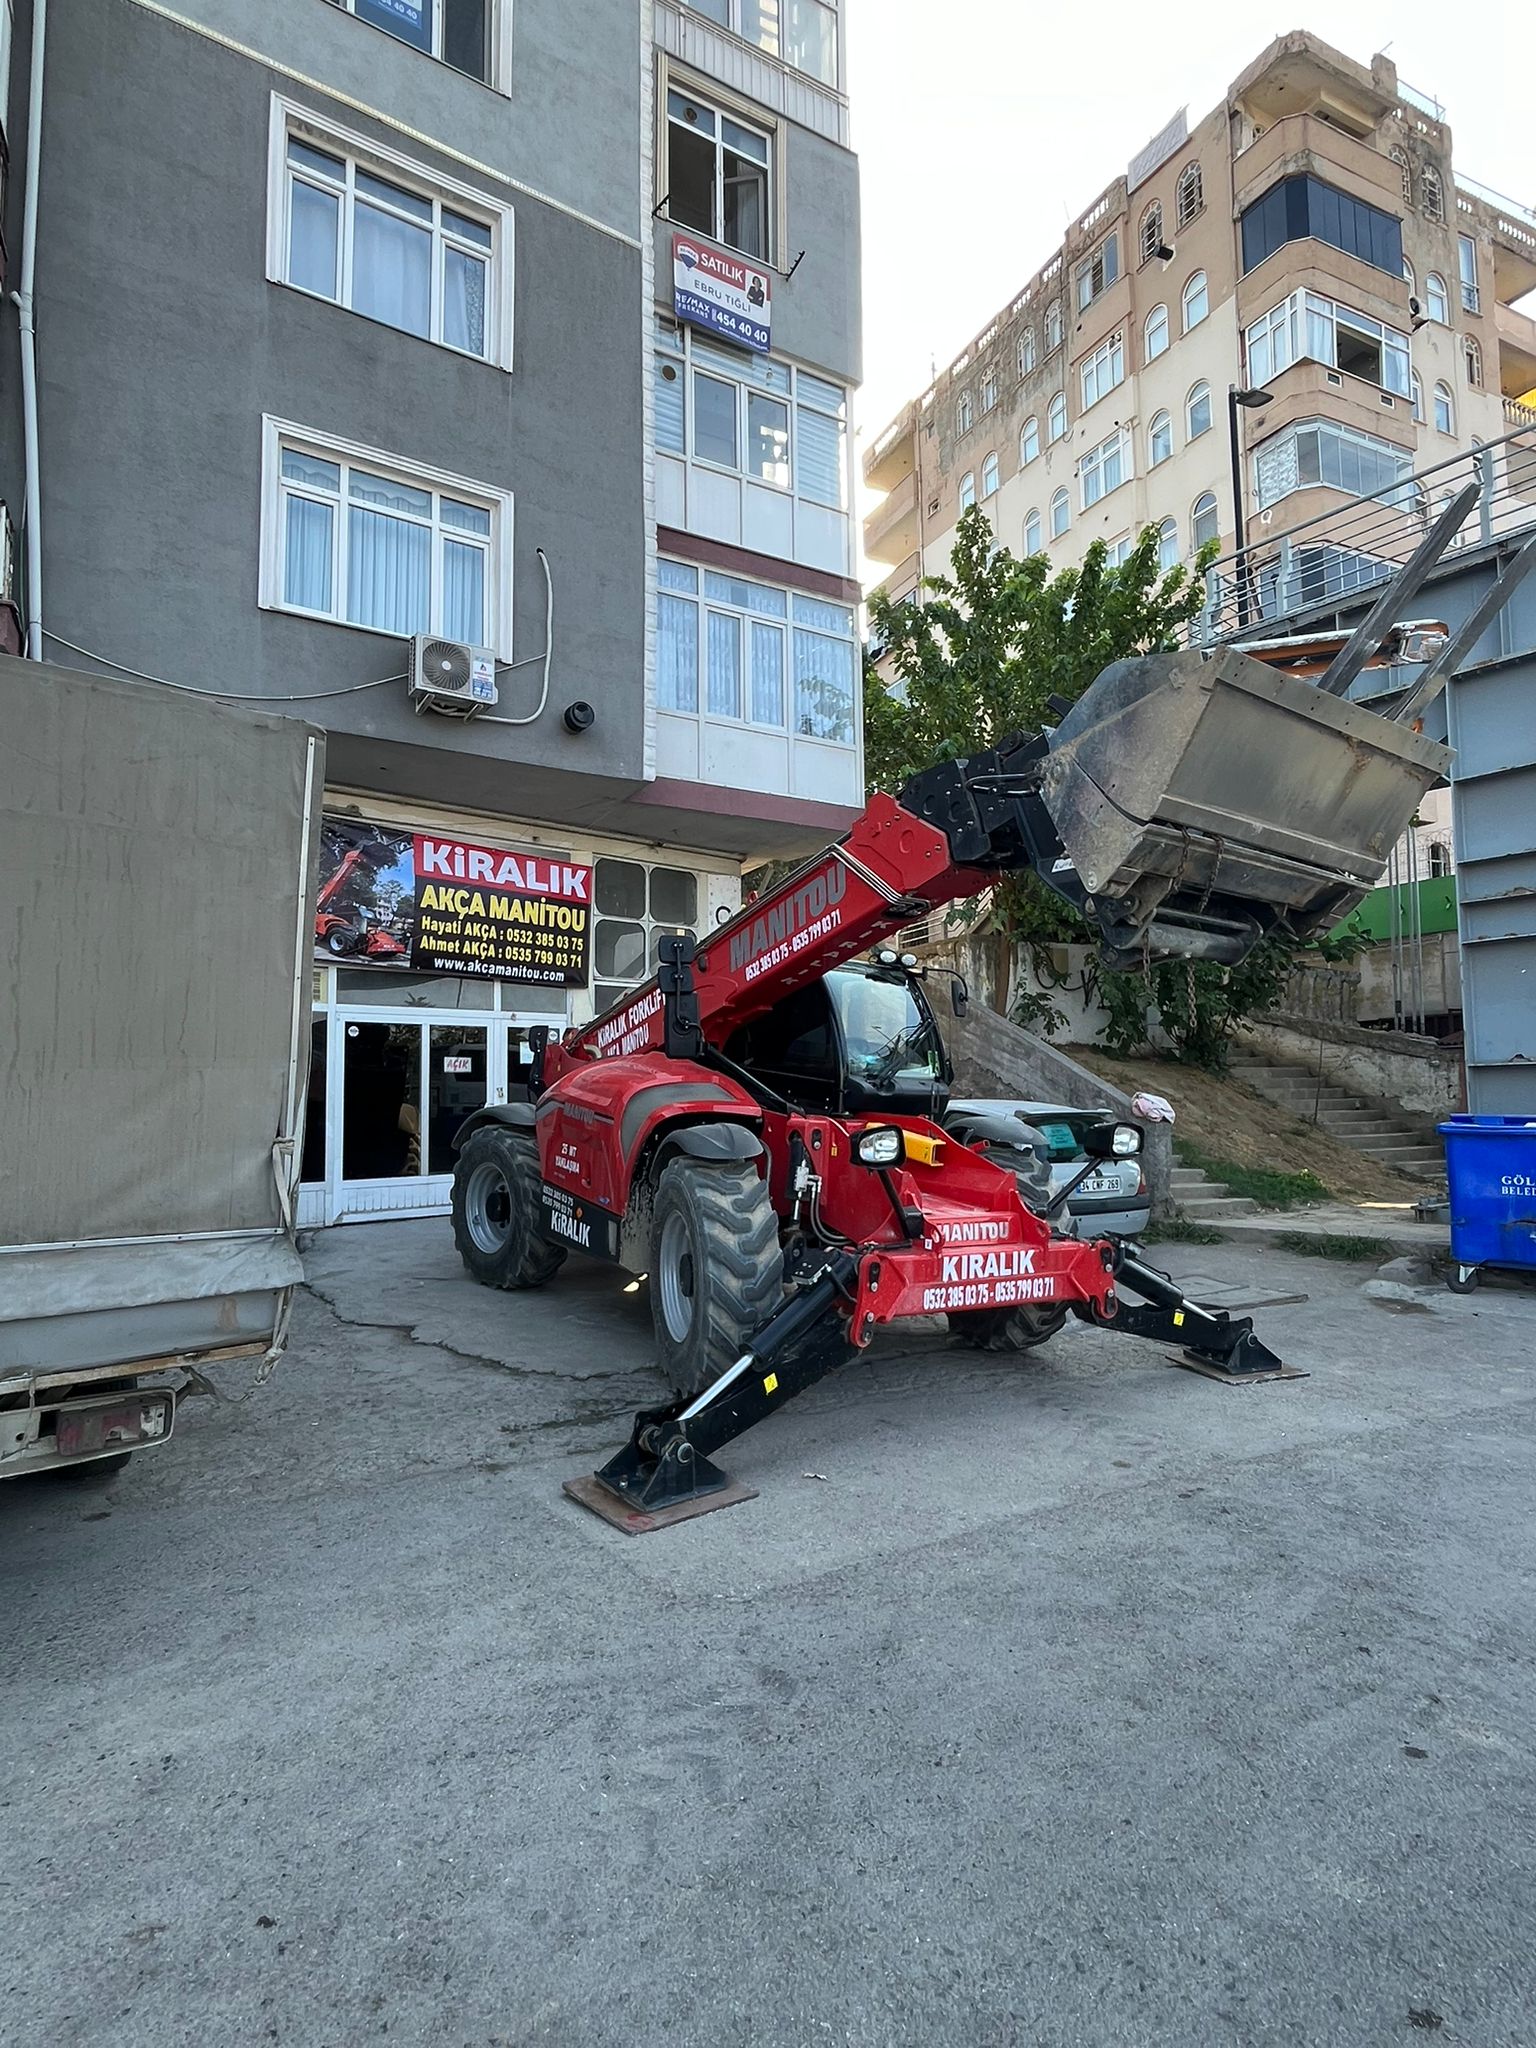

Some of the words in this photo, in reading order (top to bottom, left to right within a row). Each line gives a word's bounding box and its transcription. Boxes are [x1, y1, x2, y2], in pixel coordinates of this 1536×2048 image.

[700, 253, 744, 283] SATILIK
[676, 291, 710, 313] RE/MAX
[694, 279, 722, 299] EBRU
[716, 311, 736, 330] 454
[738, 322, 752, 337] 40
[754, 330, 768, 343] 40
[420, 884, 486, 920] AKÇA
[729, 862, 847, 974] MANITOU
[421, 915, 462, 936] Hayati
[464, 927, 498, 942] AKÇA
[506, 928, 533, 945] 0532
[535, 934, 555, 948] 385
[556, 938, 569, 950] 03
[571, 939, 584, 951] 75
[808, 920, 822, 942] 799
[821, 914, 831, 933] 03
[831, 908, 841, 925] 71
[419, 934, 460, 954] Ahmet
[462, 944, 496, 960] AKÇA
[505, 945, 532, 962] 0535
[534, 951, 554, 966] 799
[555, 955, 568, 967] 03
[570, 957, 582, 968] 71
[433, 956, 565, 983] www.akcamanitou.com
[447, 1058, 469, 1071] AÇIK
[1081, 1180, 1090, 1191] 34
[942, 1249, 1035, 1283] KIRALIK
[923, 1287, 947, 1310] 0532
[947, 1285, 964, 1307] 385
[965, 1284, 976, 1305] 03
[977, 1283, 989, 1303] 75
[995, 1280, 1016, 1302] 0535
[1016, 1279, 1032, 1299] 799
[1032, 1278, 1043, 1298] 03
[1044, 1277, 1055, 1296] 71
